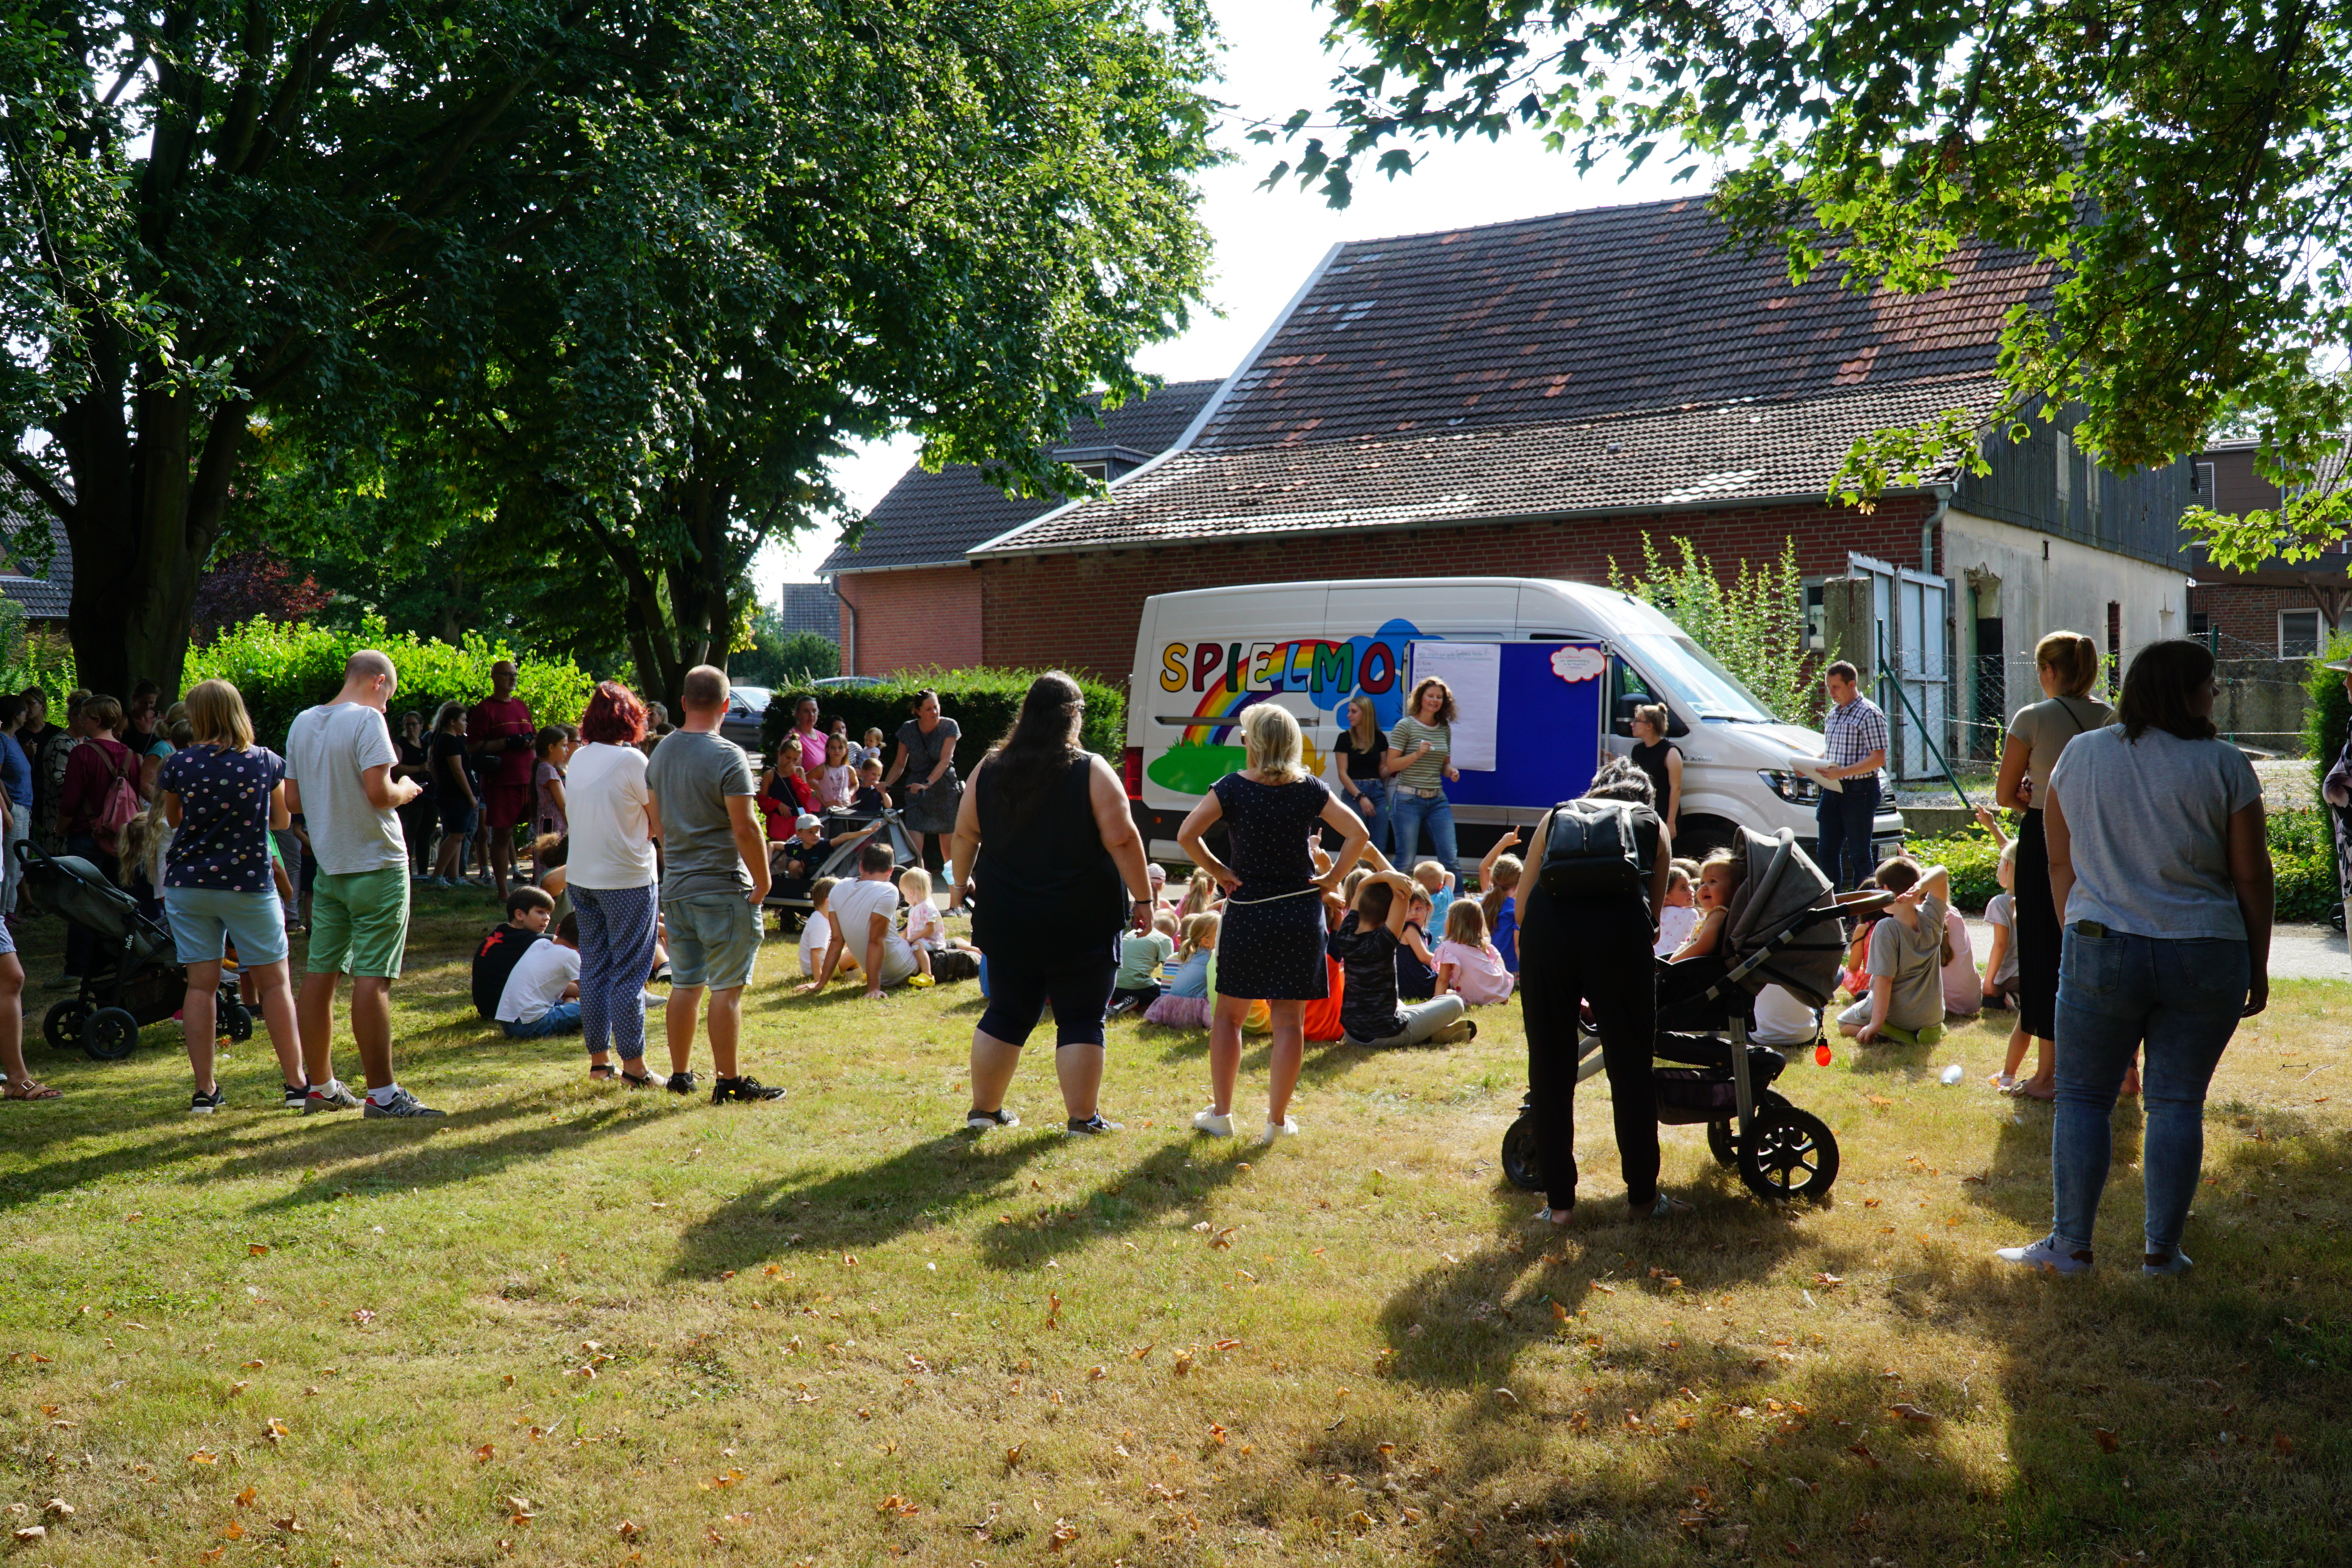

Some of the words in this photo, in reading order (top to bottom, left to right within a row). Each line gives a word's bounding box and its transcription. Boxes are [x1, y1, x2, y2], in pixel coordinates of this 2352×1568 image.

[1160, 642, 1406, 694] SPIELMO
[125, 935, 134, 950] Joie
[390, 1103, 413, 1117] N
